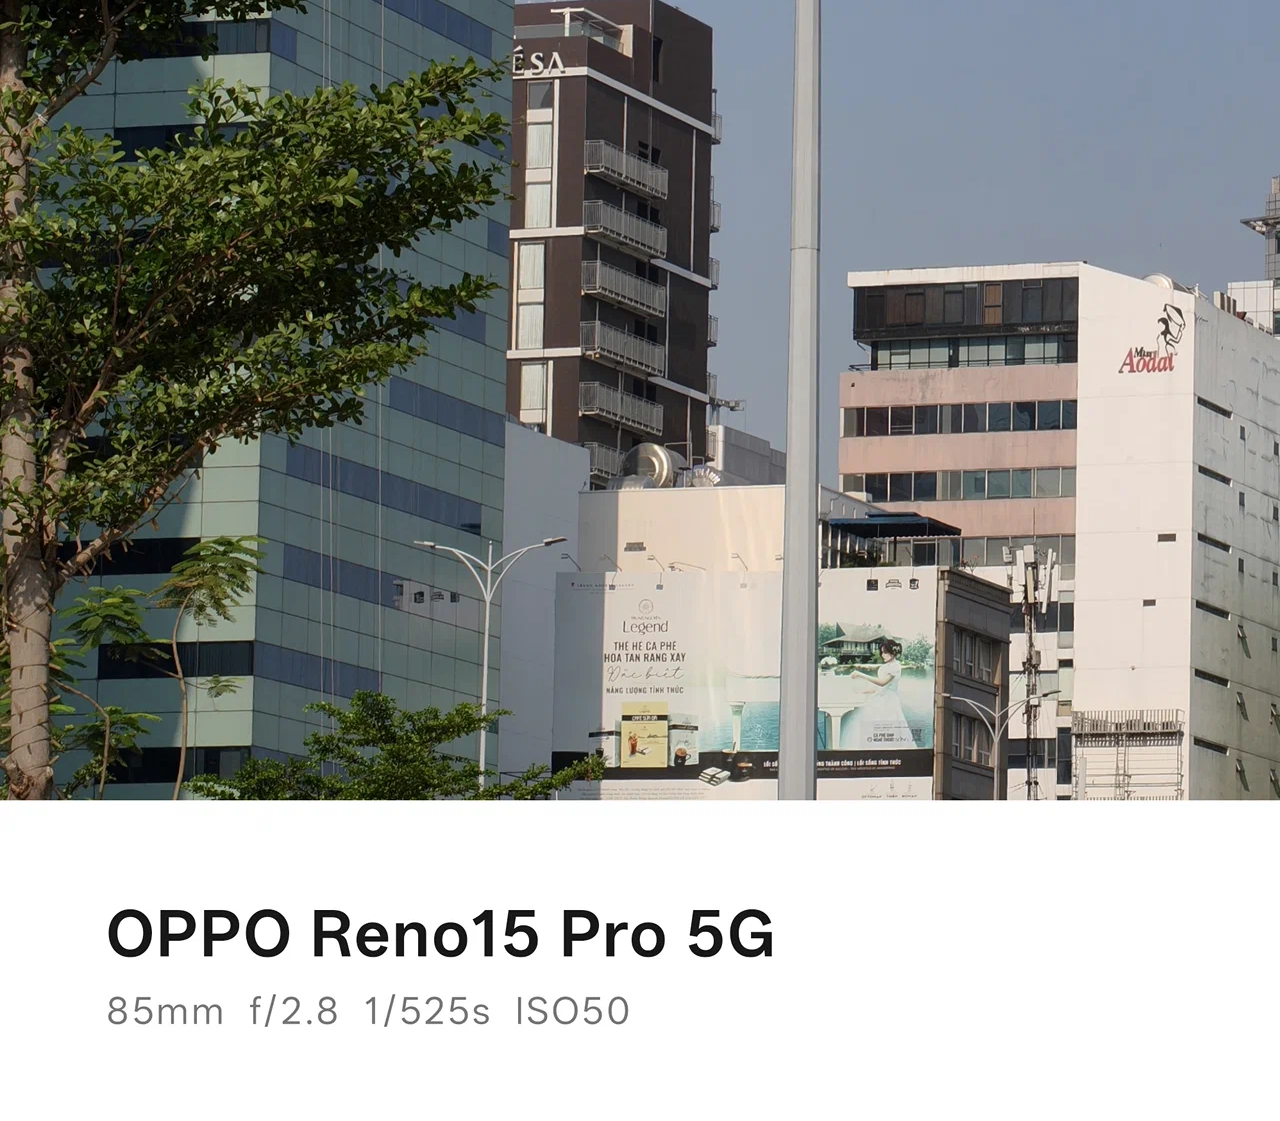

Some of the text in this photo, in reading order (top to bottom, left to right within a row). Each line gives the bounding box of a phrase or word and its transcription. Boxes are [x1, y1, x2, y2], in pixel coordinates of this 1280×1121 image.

[622, 620, 669, 635] Legend
[625, 653, 641, 662] TAN
[643, 653, 667, 662] RANG
[670, 653, 686, 662] XAY
